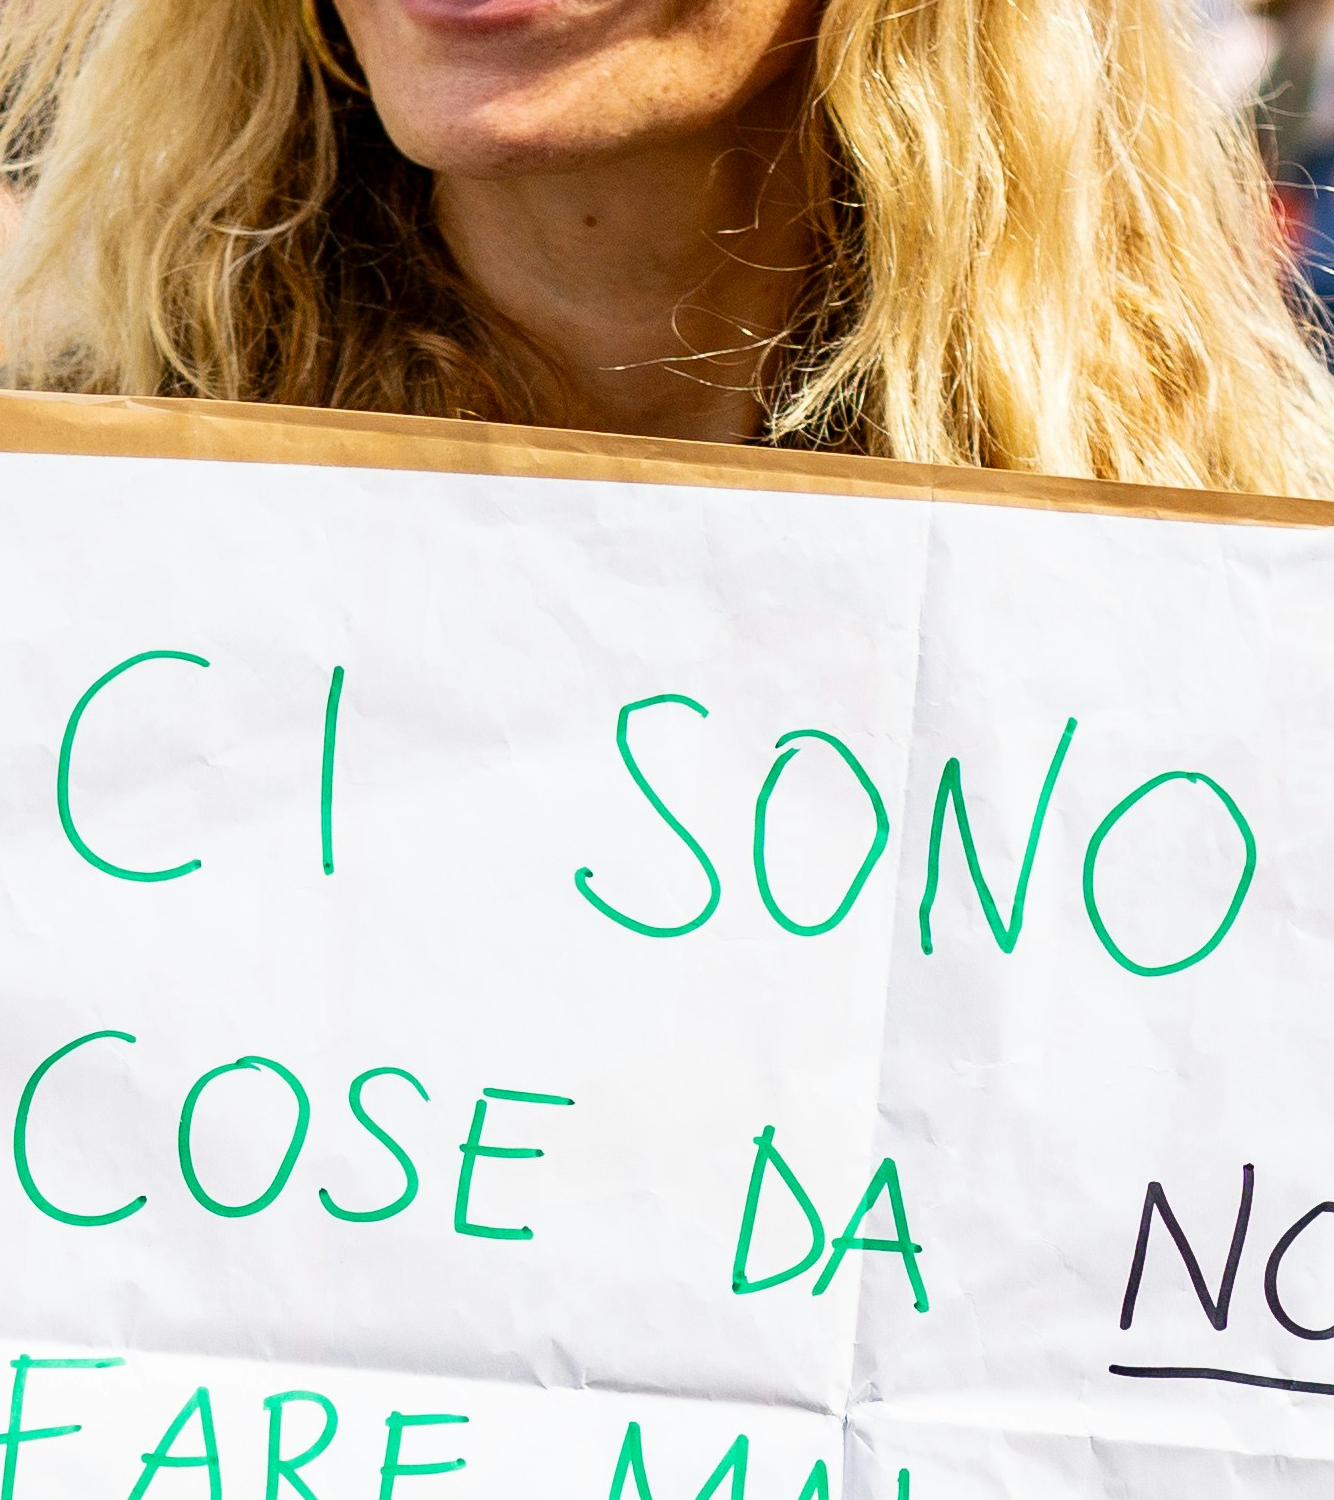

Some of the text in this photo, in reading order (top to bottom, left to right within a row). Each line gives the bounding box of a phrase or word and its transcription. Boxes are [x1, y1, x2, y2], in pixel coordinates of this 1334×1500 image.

[575, 694, 1258, 978] SONO
[13, 1030, 576, 1241] COSE
[732, 1125, 929, 1313] DA
